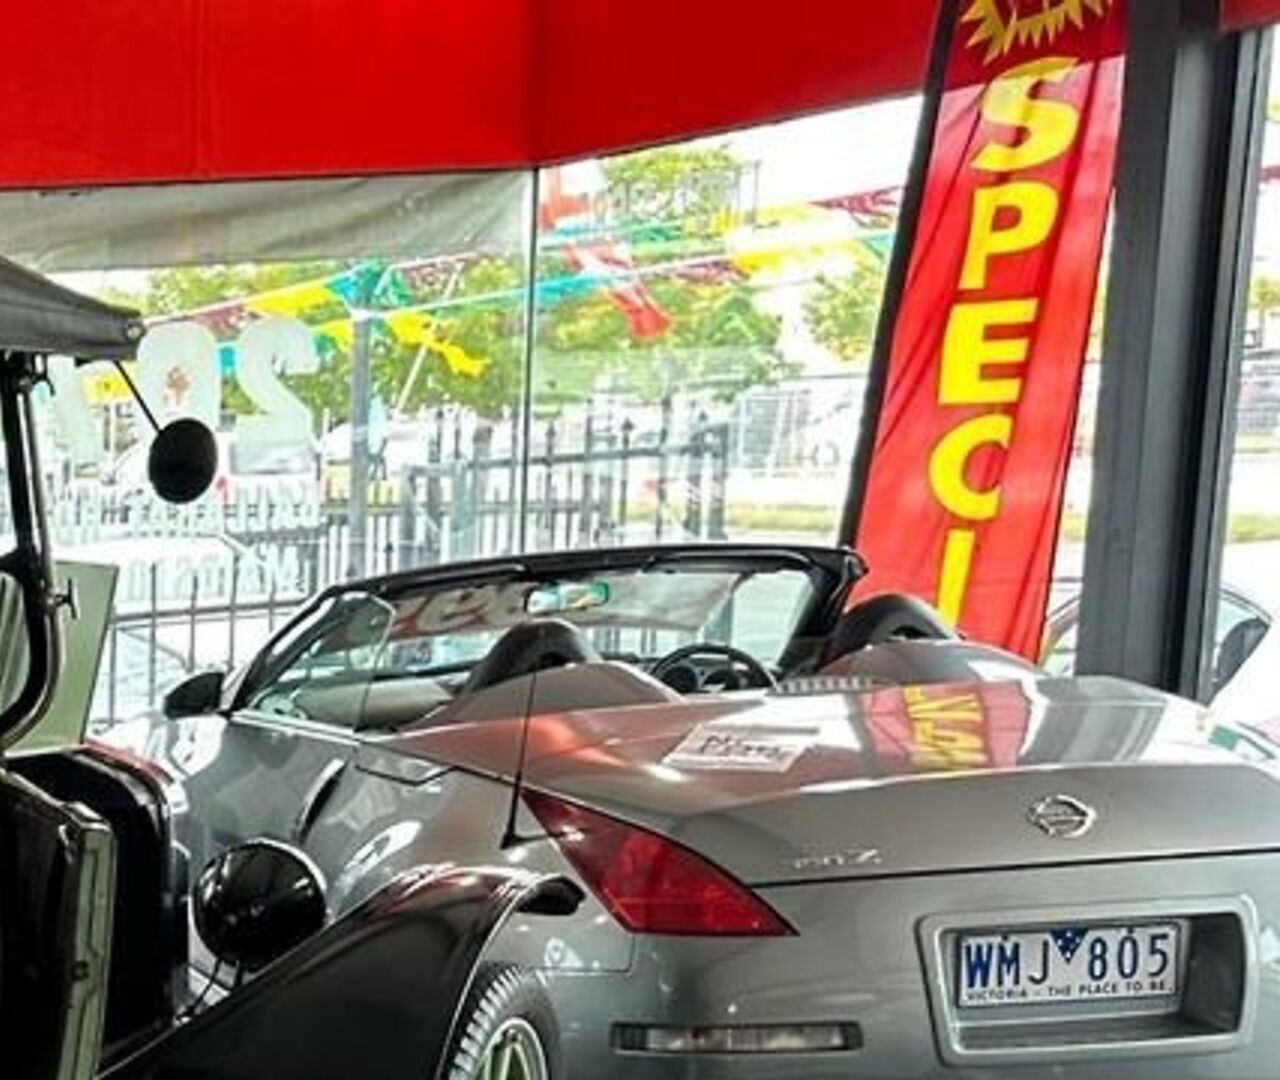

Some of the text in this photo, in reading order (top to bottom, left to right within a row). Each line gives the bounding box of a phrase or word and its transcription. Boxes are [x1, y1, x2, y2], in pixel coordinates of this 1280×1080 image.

[964, 933, 1170, 988] WMJ 805
[966, 989, 1028, 1001] VICTORIA
[1048, 985, 1071, 997] THE
[1078, 982, 1117, 995] PLACE
[1126, 981, 1143, 993] TO
